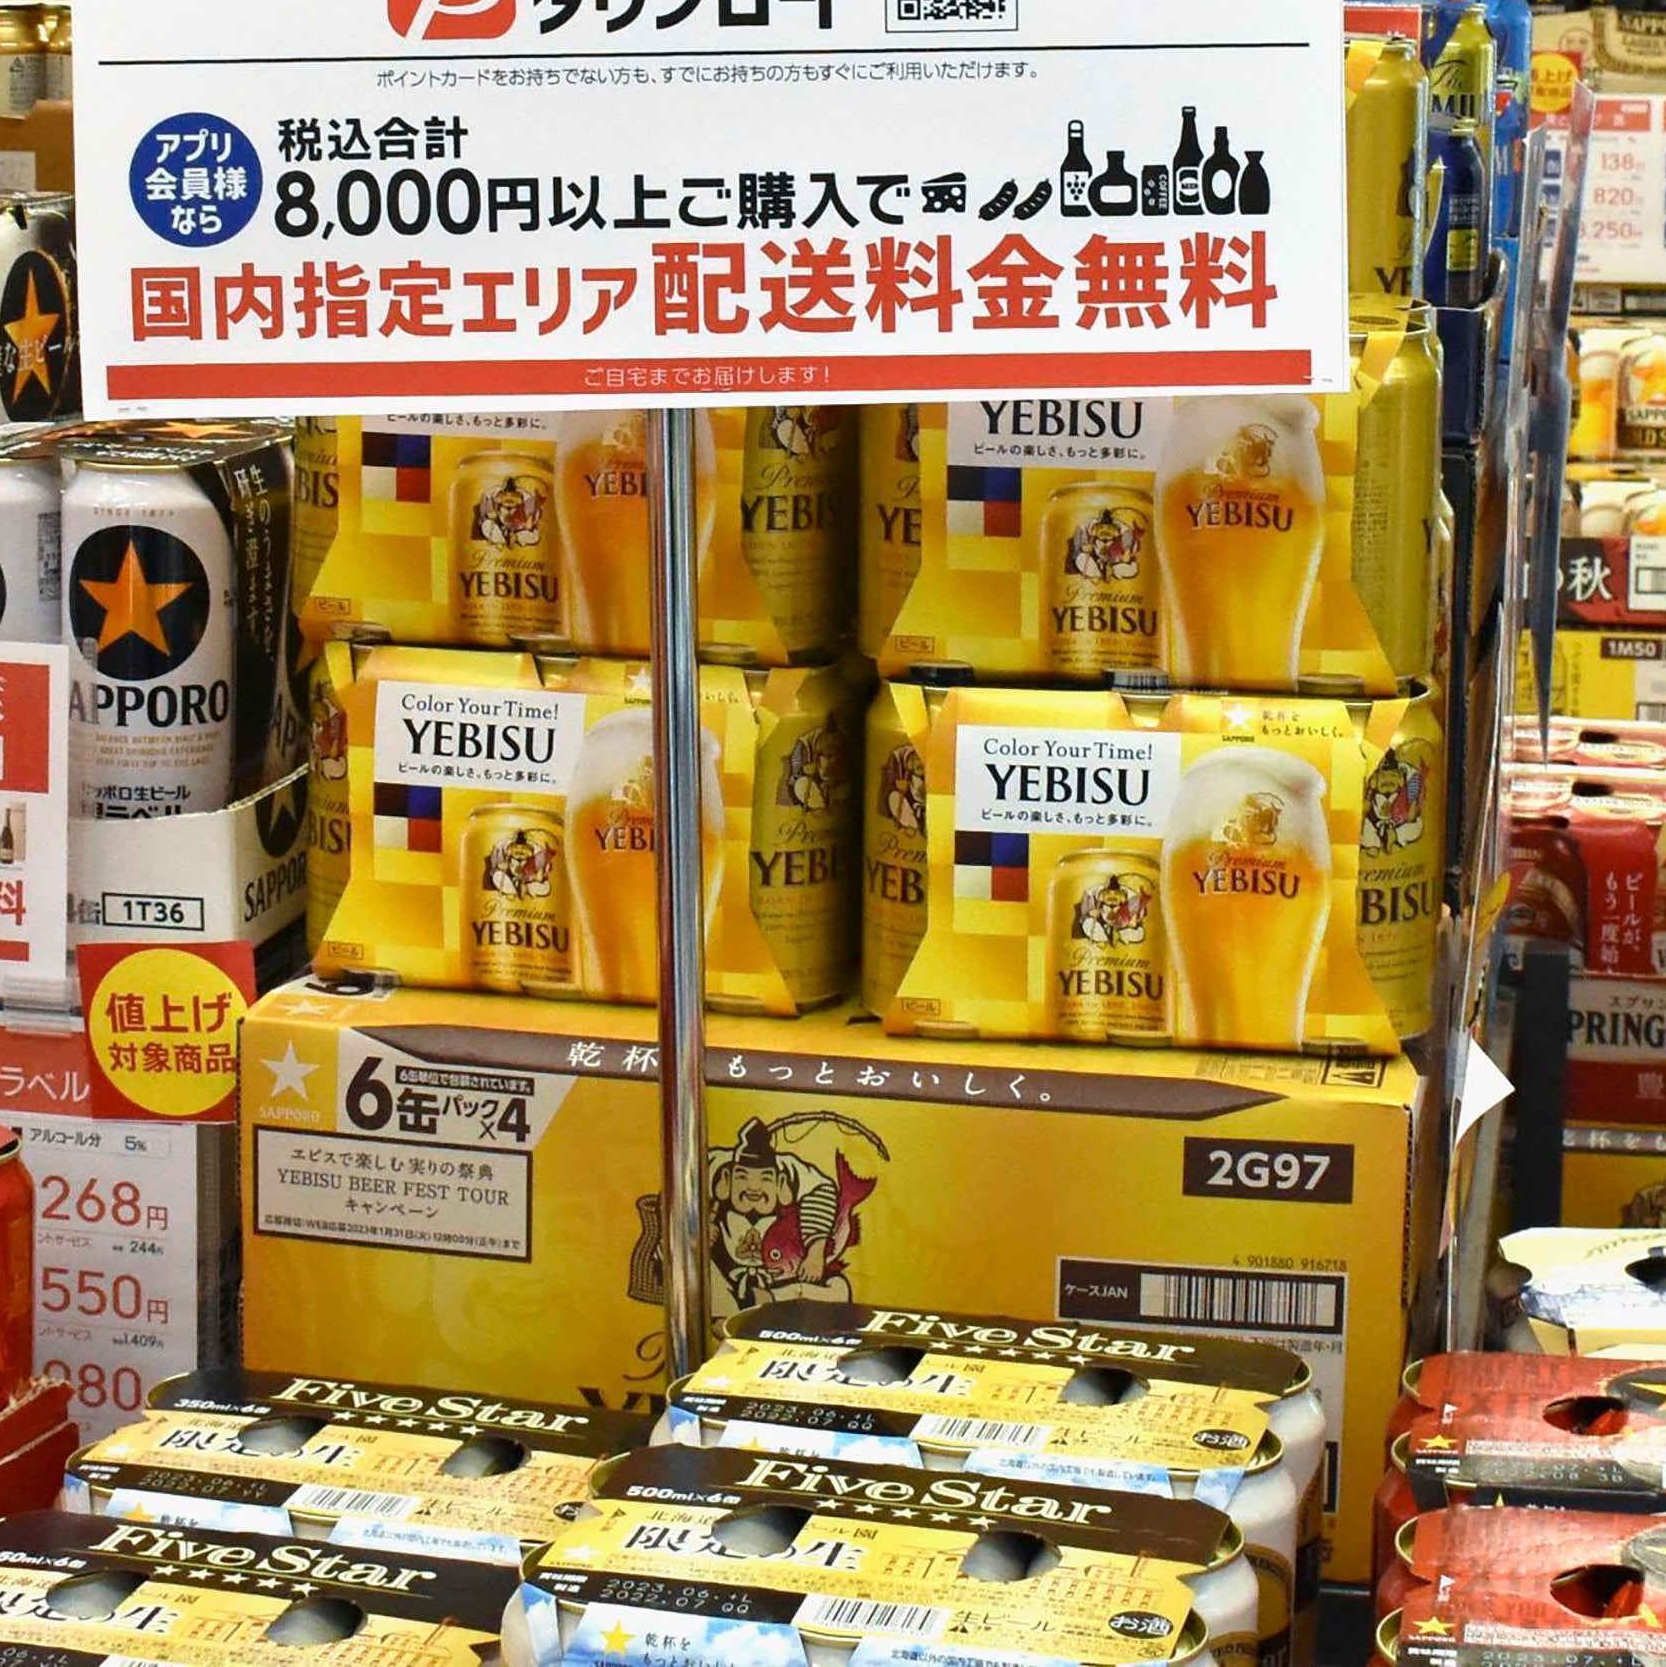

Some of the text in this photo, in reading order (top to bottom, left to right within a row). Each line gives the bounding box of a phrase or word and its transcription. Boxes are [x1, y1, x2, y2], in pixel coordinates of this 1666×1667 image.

[156, 131, 235, 164] アプリ
[278, 116, 468, 164] 税込合計
[145, 167, 248, 203] 会員様
[274, 160, 911, 241] 8,000円以上ご購入で
[169, 203, 224, 237] なら
[132, 230, 1278, 343] 国内指定エリア配送料金無料
[973, 443, 1146, 460] ビールの楽しさ、もっと多彩に。
[459, 572, 559, 603] YEBISU
[1608, 641, 1657, 657] 1M50
[401, 692, 559, 721] Color Your Time!
[402, 718, 556, 764] YEBISU
[983, 739, 1152, 761] Color Your Time!
[985, 764, 1151, 806] YEBISU
[980, 809, 1154, 828] ビールの楽しさ、もっと多彩に。
[123, 899, 185, 924] 1T36
[106, 992, 232, 1036] 値上げ
[108, 1042, 236, 1076] 対象商品
[278, 1168, 509, 1206] YEBISU BEER FEST TOUR
[1207, 1149, 1331, 1193] 2G97
[39, 1174, 169, 1232] 268円
[345, 1196, 439, 1219] キャンペーン
[1247, 1255, 1348, 1272] 901880 916718
[1064, 1283, 1129, 1301] ケースJAN
